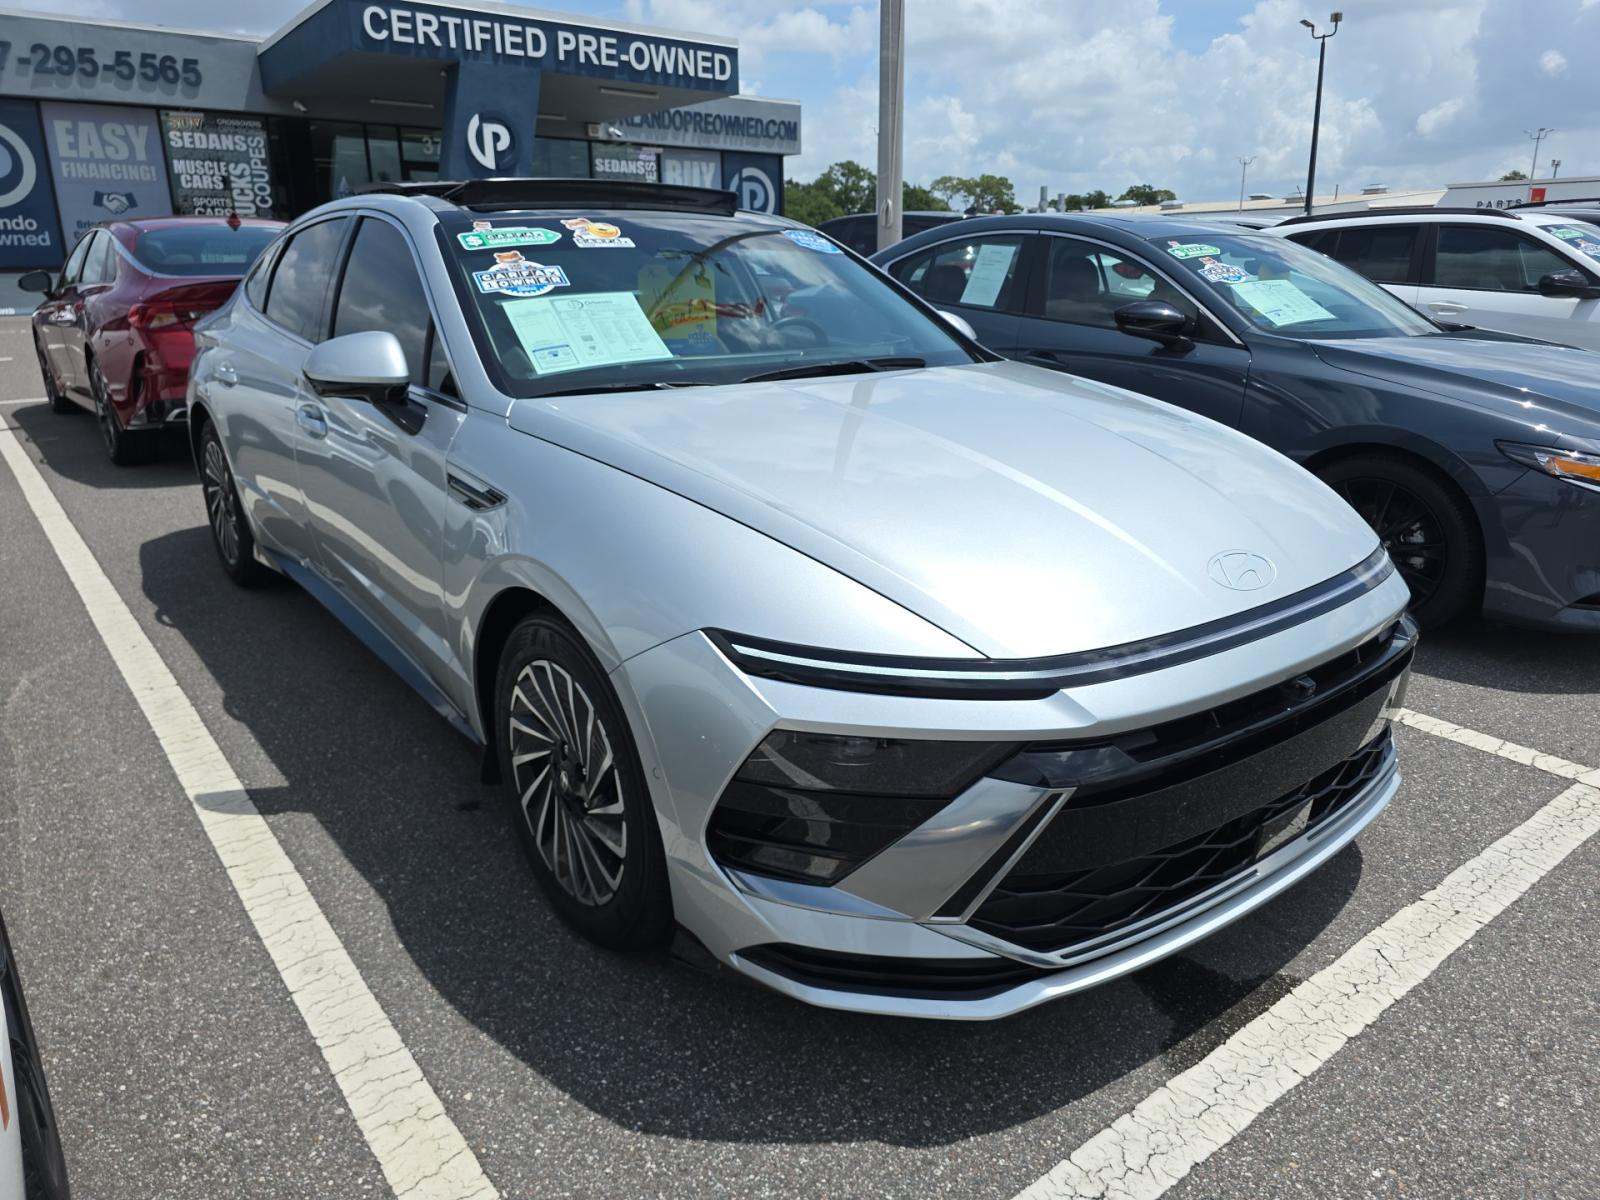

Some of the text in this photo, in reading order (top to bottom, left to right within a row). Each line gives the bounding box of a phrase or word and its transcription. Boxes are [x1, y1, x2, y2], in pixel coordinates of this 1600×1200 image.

[363, 5, 732, 81] CERTIFIED PRE-OWNED
[53, 120, 149, 161] EASY
[169, 131, 248, 151] SEDANS
[61, 161, 158, 181] FINANCING!
[173, 159, 229, 176] MUSCLE
[247, 135, 273, 208] COUPES
[595, 158, 645, 175] SEDANS
[180, 174, 224, 189] CARS
[192, 196, 233, 207] SPORTS
[1476, 198, 1522, 209] PARTS
